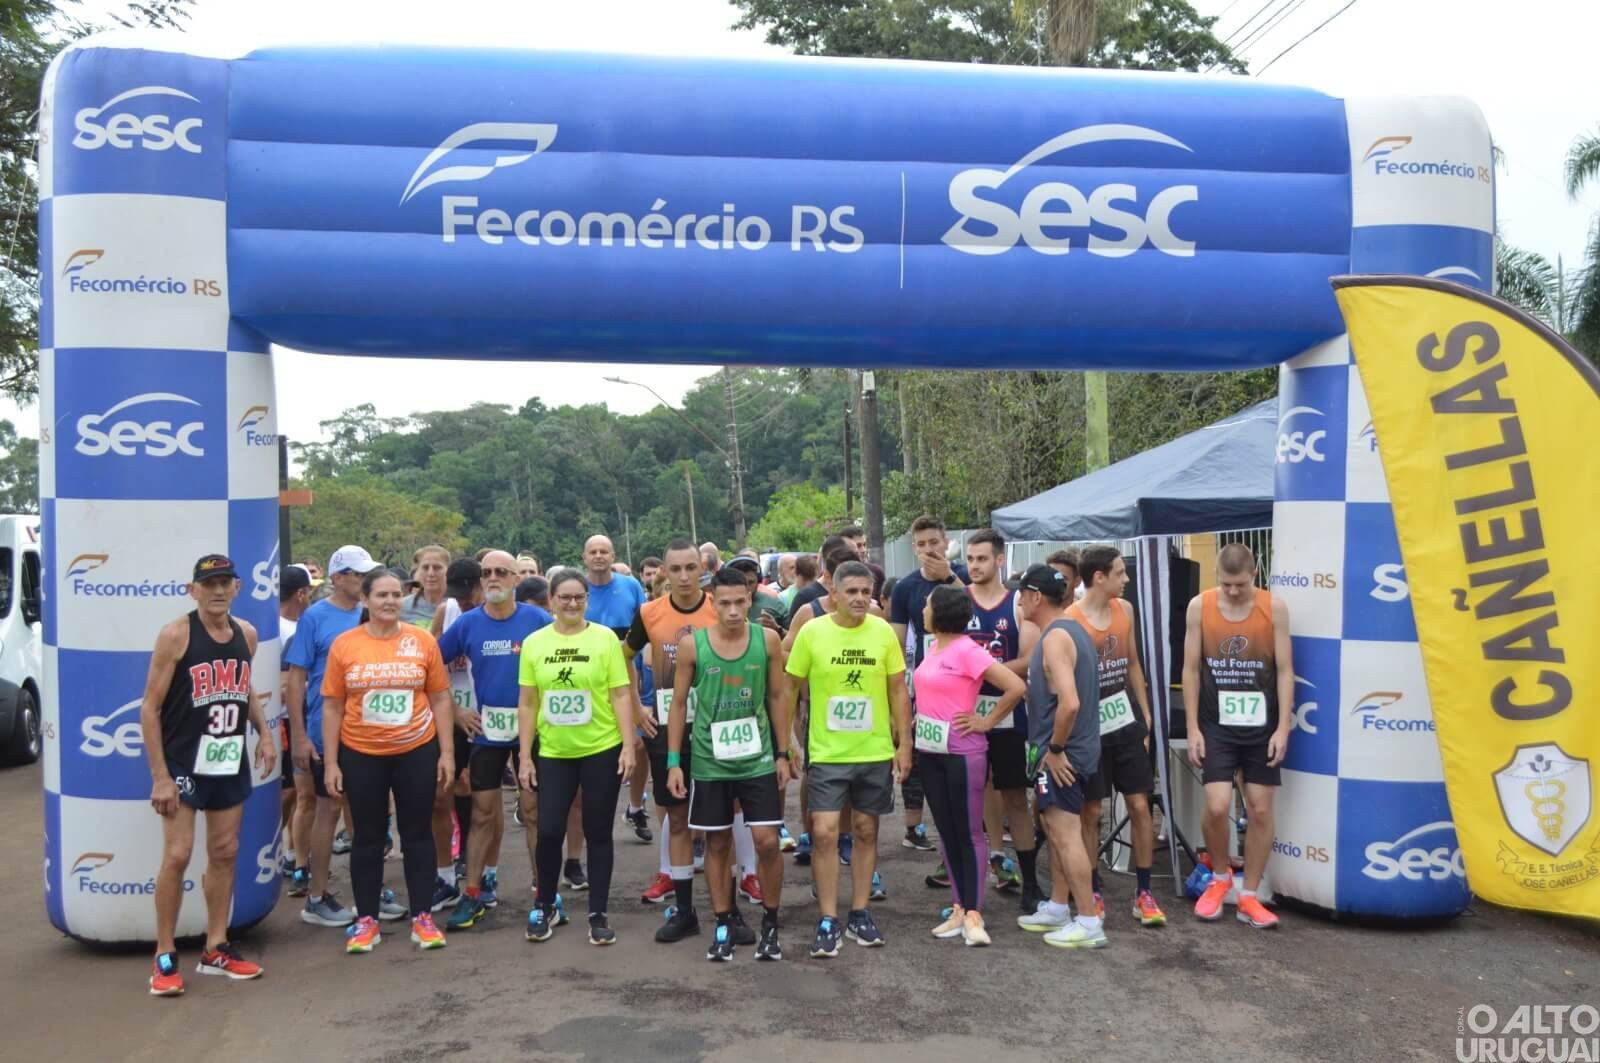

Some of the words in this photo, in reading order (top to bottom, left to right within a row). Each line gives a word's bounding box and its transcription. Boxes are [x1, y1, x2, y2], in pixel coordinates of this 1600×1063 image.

[72, 106, 203, 154] Sesc
[1374, 159, 1475, 179] Fecomércio
[1478, 167, 1491, 185] RS
[940, 168, 1199, 258] Sesc
[441, 195, 772, 250] Fecomércio
[790, 204, 865, 253] RS
[70, 275, 187, 295] Fecomércio
[193, 279, 222, 297] RS
[74, 414, 205, 457] Sesc
[1273, 429, 1326, 464] esc
[1415, 320, 1574, 722] CAÑELLAS
[73, 578, 189, 598] Fecomércio
[1313, 573, 1337, 589] RS
[831, 656, 876, 666] PALMITINHO
[842, 649, 866, 657] CORRE
[1229, 658, 1264, 669] Forma
[368, 693, 407, 714] 493
[453, 689, 472, 708] 51
[548, 694, 586, 714] 623
[1224, 696, 1260, 715] 517
[207, 703, 240, 735] 30
[486, 711, 516, 731] 381
[833, 701, 867, 721] 427
[719, 723, 754, 745] 449
[915, 718, 943, 744] 586
[205, 741, 241, 763] 663
[1306, 845, 1329, 863] RS
